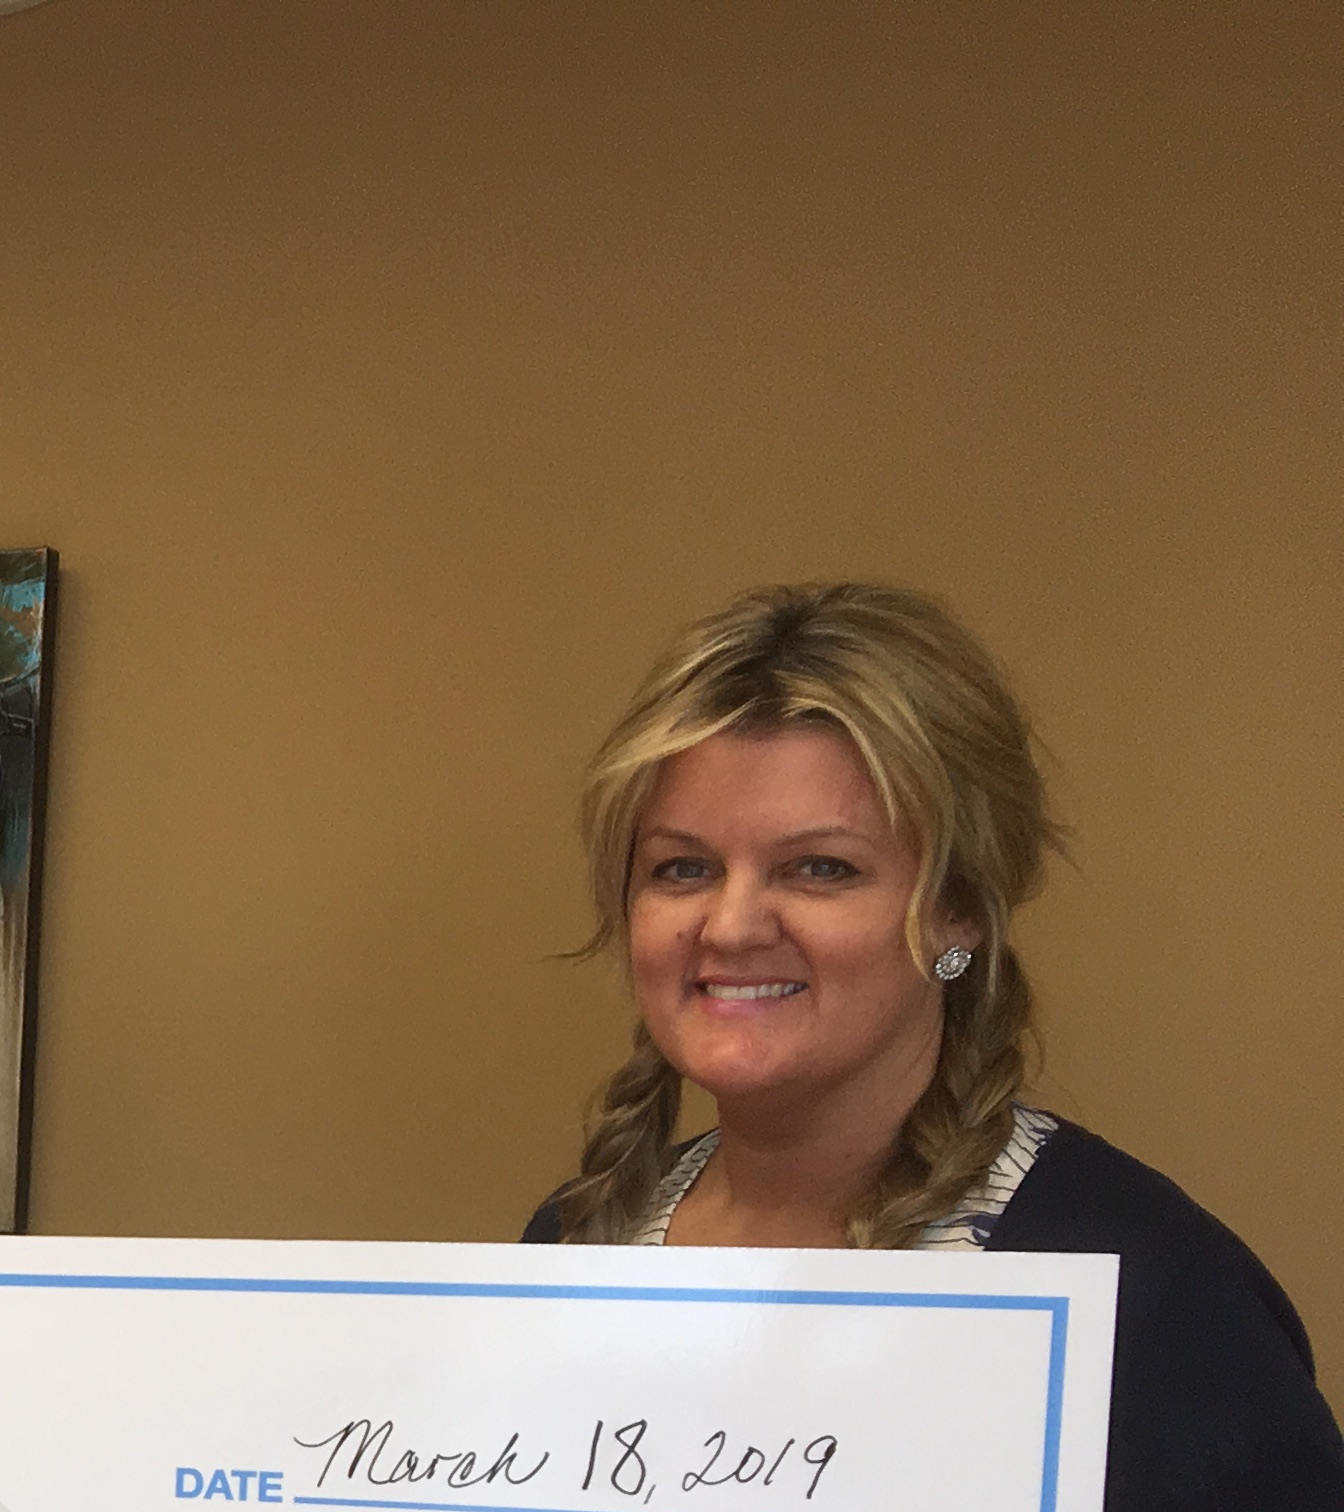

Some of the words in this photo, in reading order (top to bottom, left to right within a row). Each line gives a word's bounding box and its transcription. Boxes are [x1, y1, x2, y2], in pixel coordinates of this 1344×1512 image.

[174, 1466, 284, 1504] DATE
[294, 1418, 550, 1490] March
[581, 1419, 659, 1505] 18,
[682, 1430, 839, 1499] 2019
